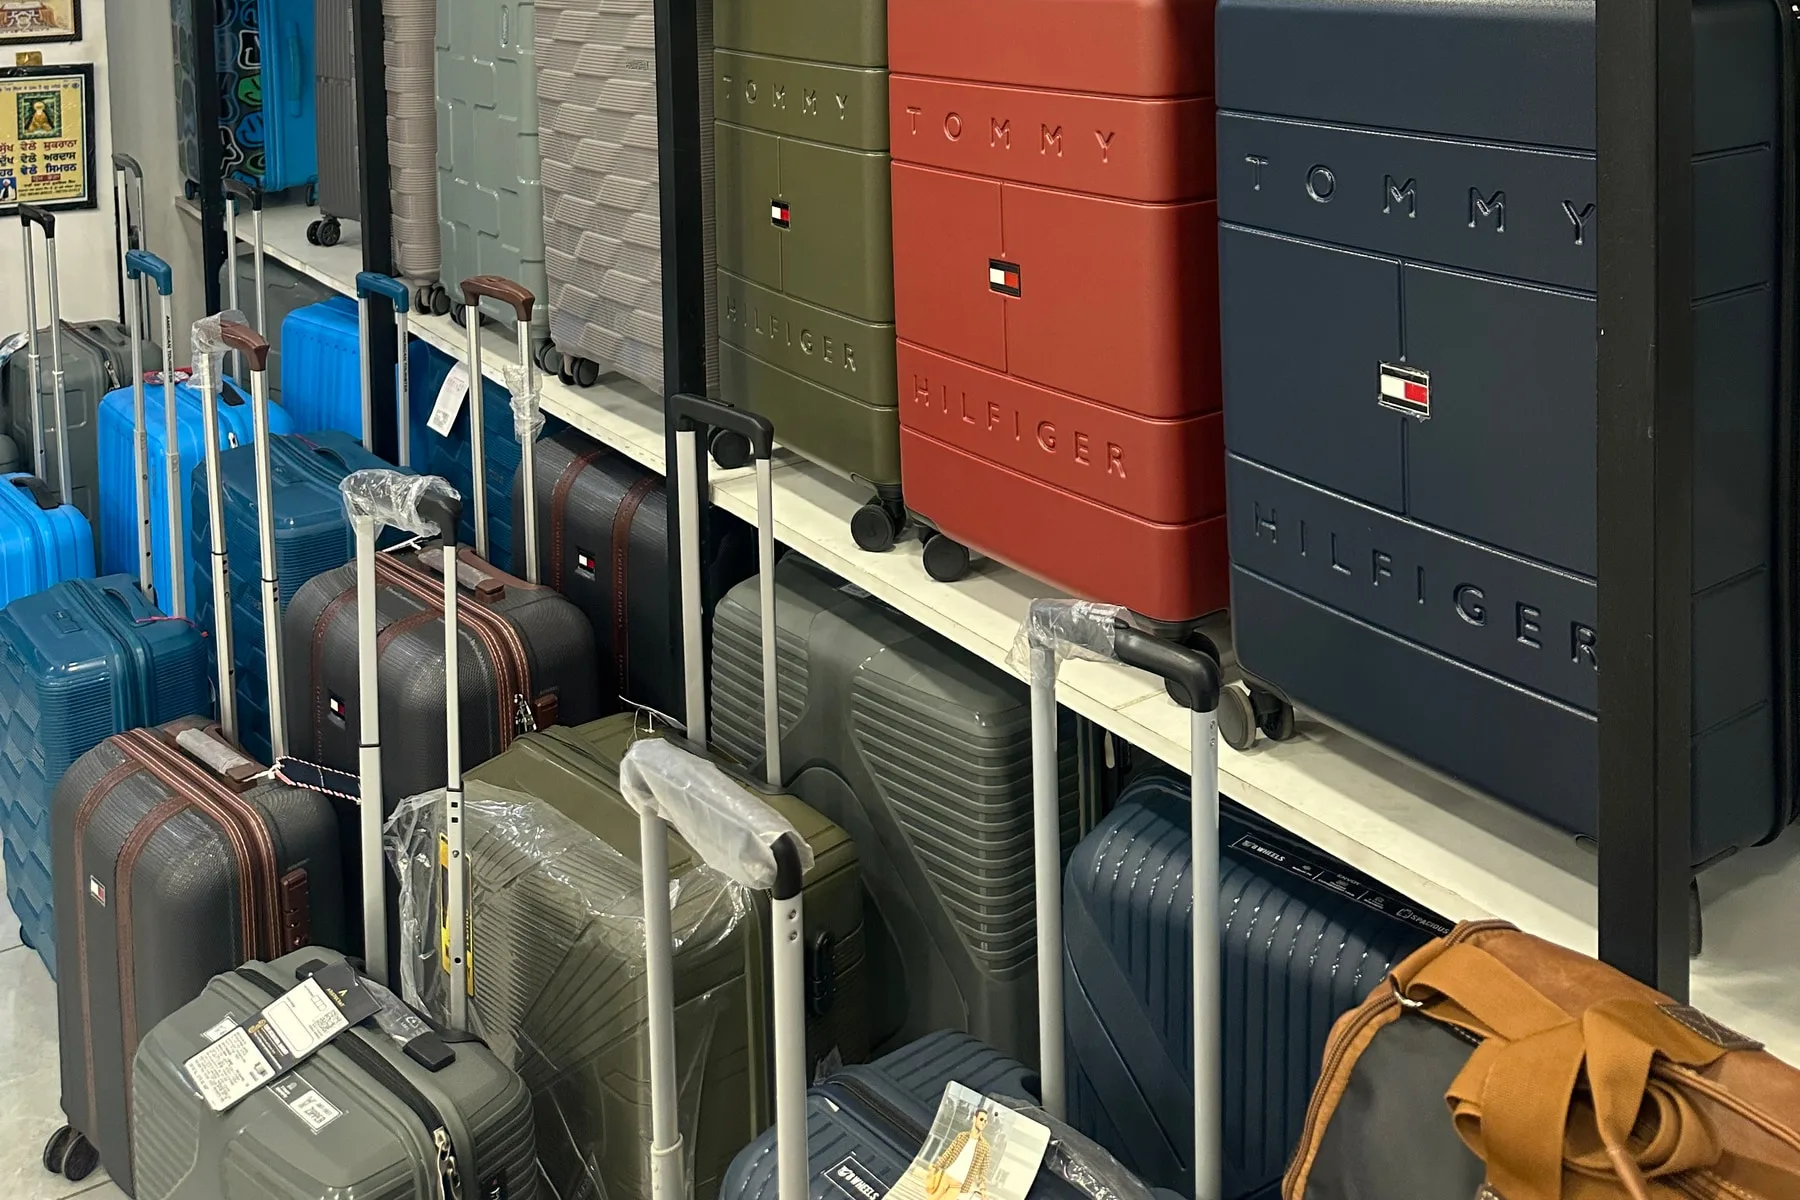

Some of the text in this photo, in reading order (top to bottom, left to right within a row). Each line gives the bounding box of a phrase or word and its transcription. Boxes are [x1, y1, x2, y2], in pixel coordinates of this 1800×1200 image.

[723, 75, 849, 120] TOMMY
[906, 106, 1116, 163] TOMMY
[1245, 154, 1597, 246] TOMMY
[725, 295, 857, 373] HILFIGER
[913, 373, 1127, 479] HILFIGER
[1253, 501, 1599, 671] HILFIGER
[1257, 846, 1285, 862] WHEELS
[1410, 914, 1450, 935] SPACIOUS
